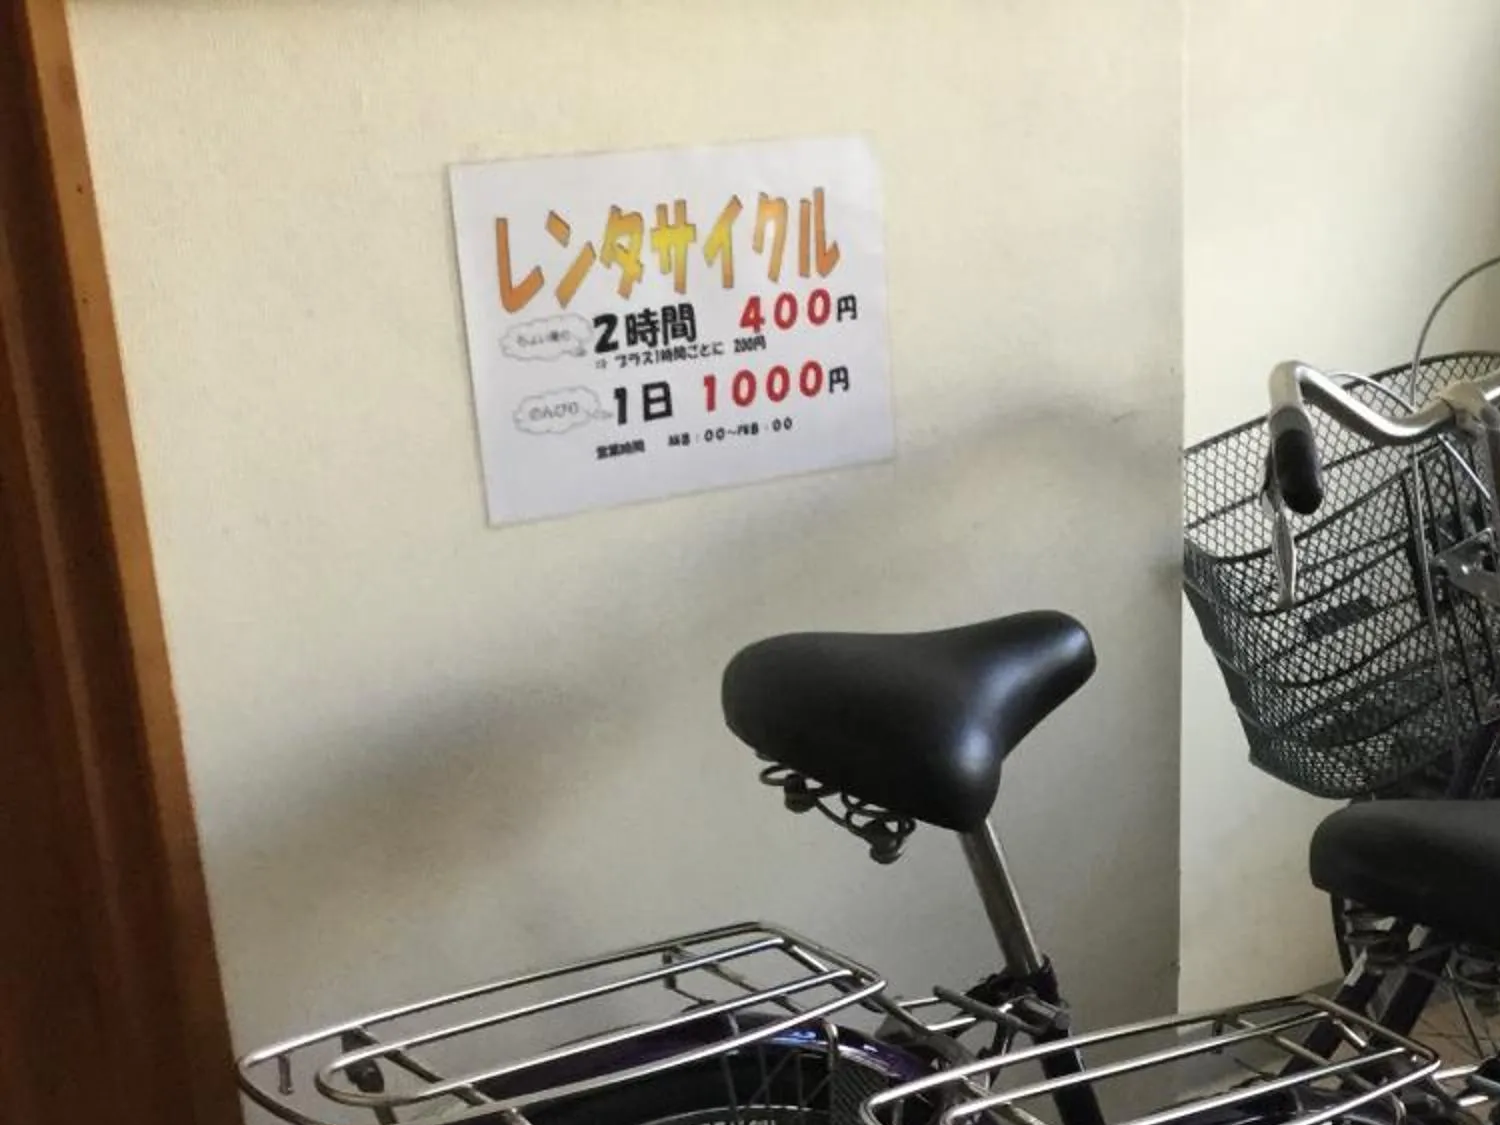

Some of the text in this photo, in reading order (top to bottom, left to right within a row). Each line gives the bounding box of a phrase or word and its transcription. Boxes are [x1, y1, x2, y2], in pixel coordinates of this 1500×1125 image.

[496, 187, 841, 314] レンタサイクル
[594, 288, 858, 353] 2時間 400円
[614, 361, 849, 425] 1日 1000円
